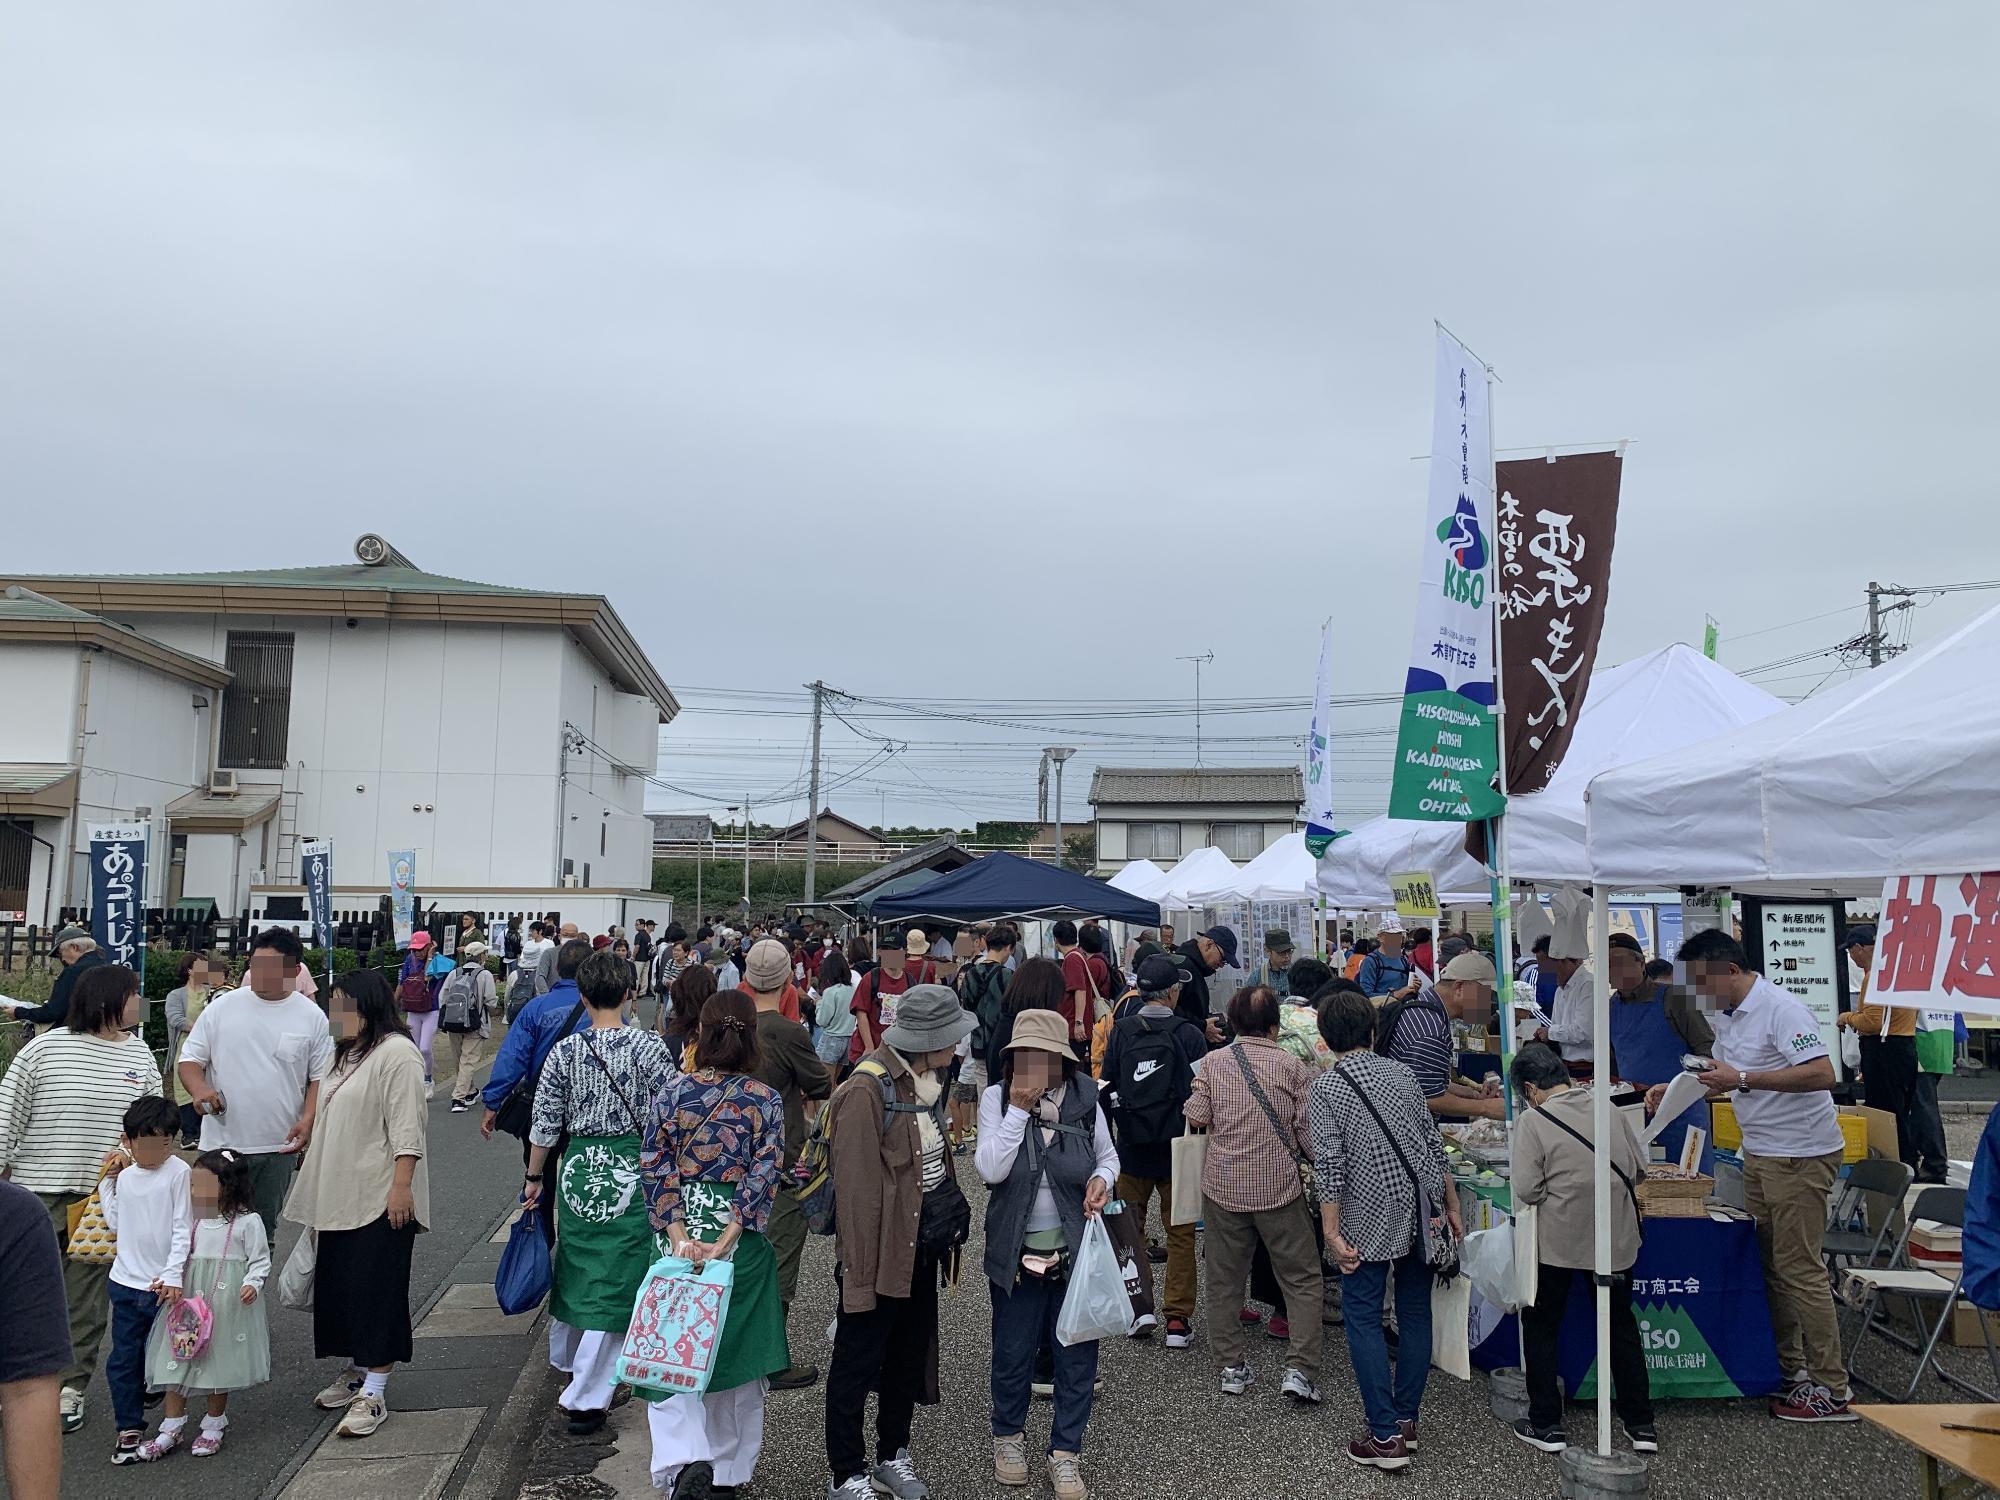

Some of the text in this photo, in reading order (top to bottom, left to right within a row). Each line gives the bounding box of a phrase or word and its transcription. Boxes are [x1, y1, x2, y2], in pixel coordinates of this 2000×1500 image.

[1443, 558, 1484, 610] KISO
[1782, 912, 1826, 924] 新居関所
[1137, 1060, 1157, 1073] NIKE
[1639, 1320, 1681, 1350] iso
